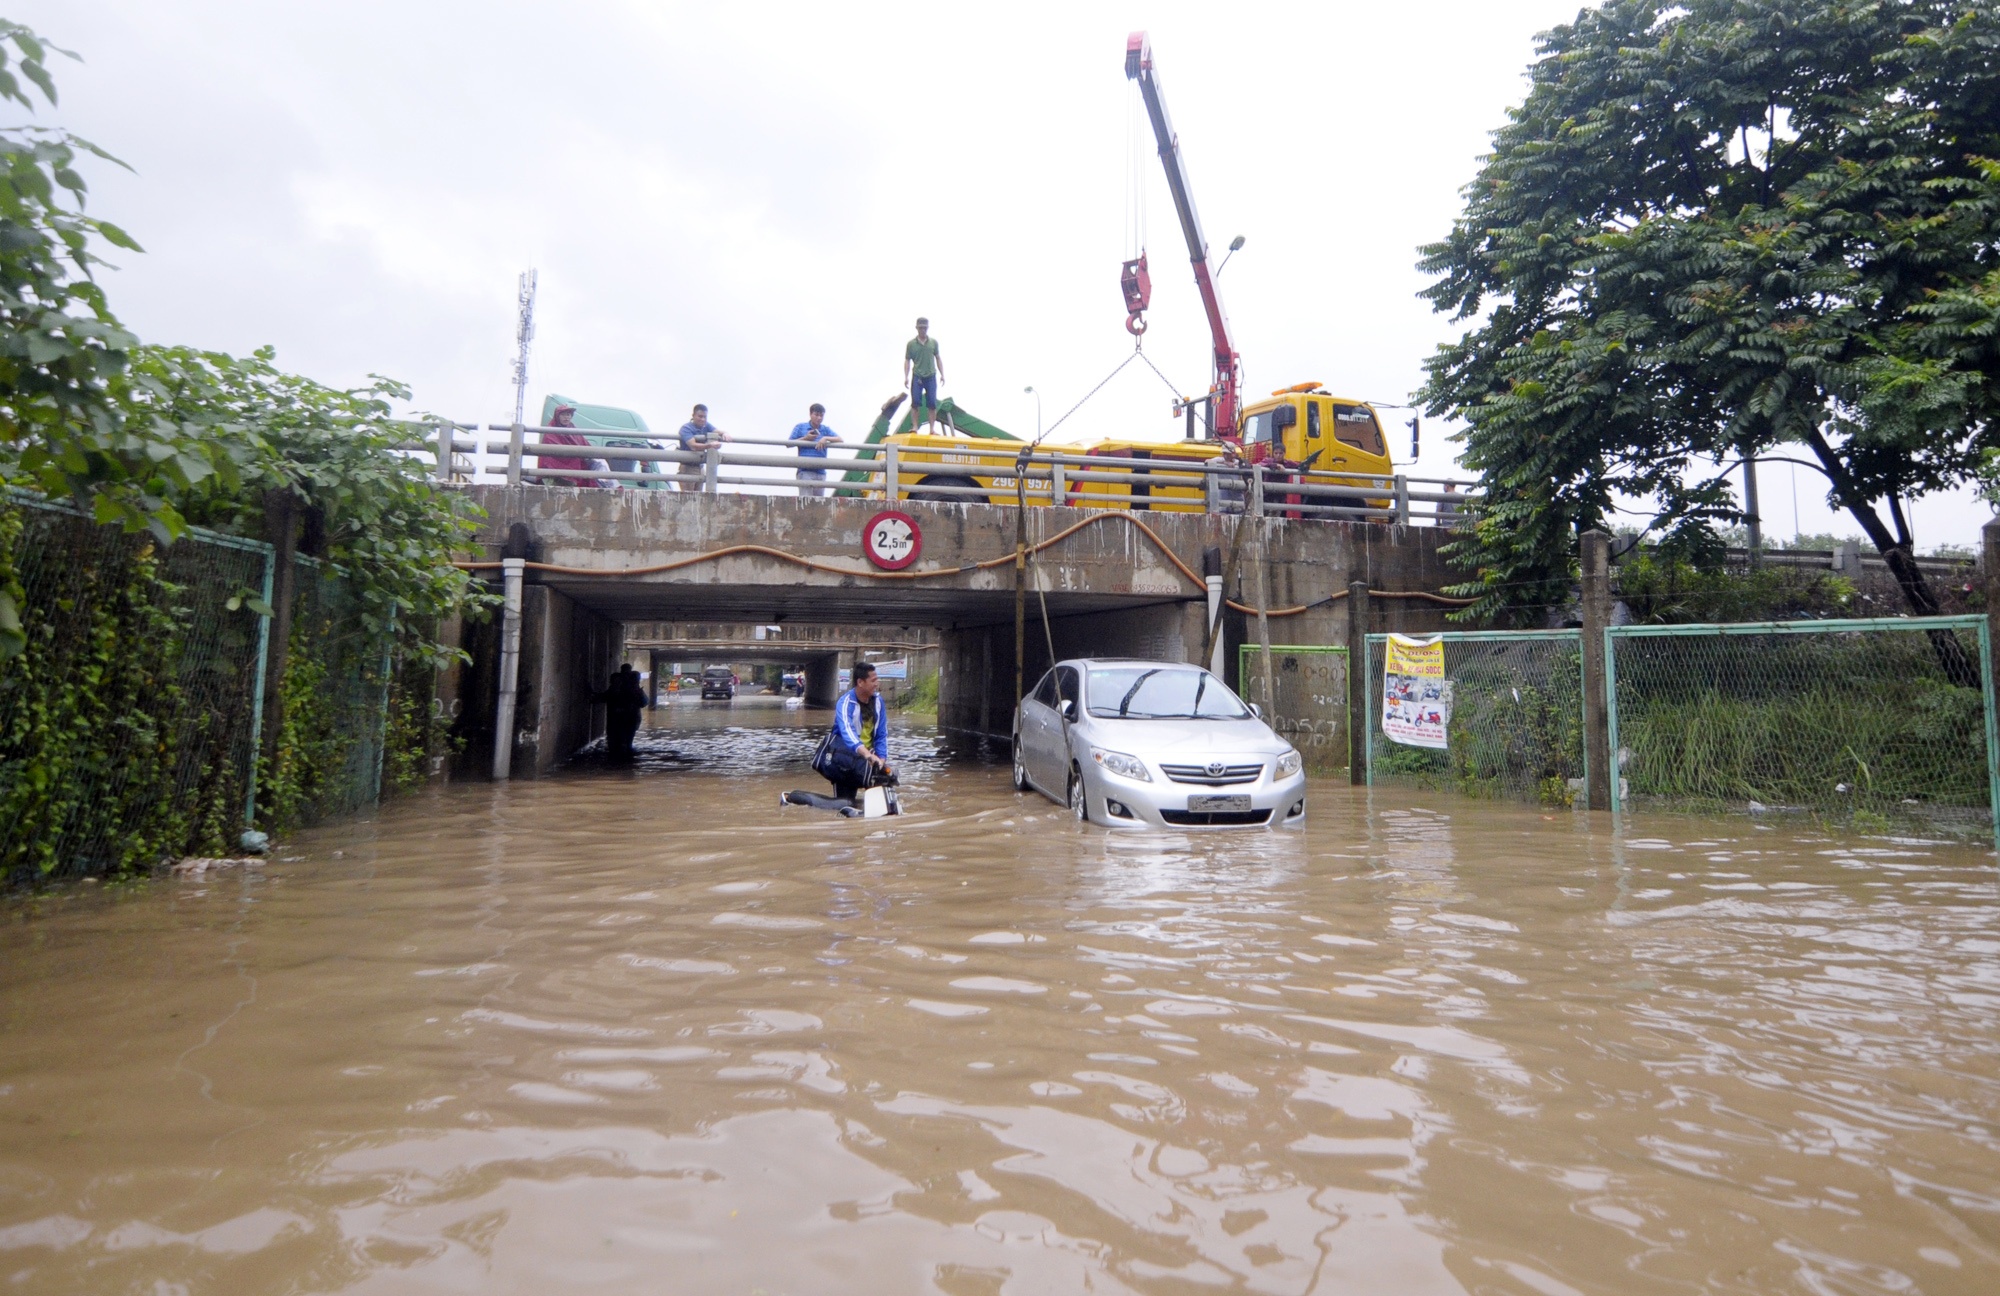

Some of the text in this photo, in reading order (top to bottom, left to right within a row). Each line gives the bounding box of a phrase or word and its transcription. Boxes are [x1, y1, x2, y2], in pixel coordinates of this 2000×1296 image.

[992, 477, 1052, 490] 29C 957
[878, 531, 907, 550] 2,5m
